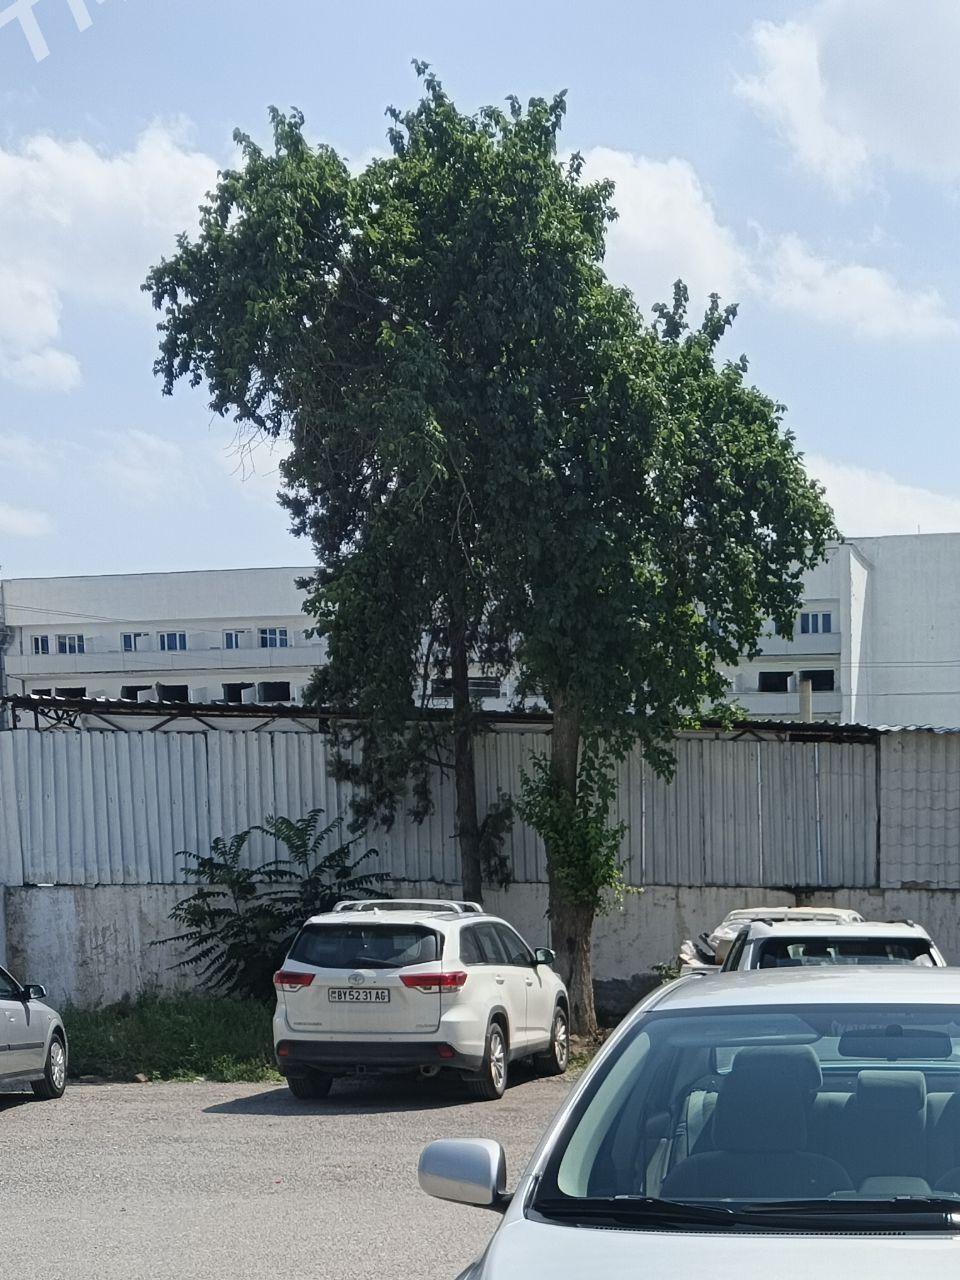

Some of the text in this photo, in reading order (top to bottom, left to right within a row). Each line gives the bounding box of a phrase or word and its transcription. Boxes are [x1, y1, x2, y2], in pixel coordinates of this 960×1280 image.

[337, 990, 386, 1001] BY 52 31 AG
